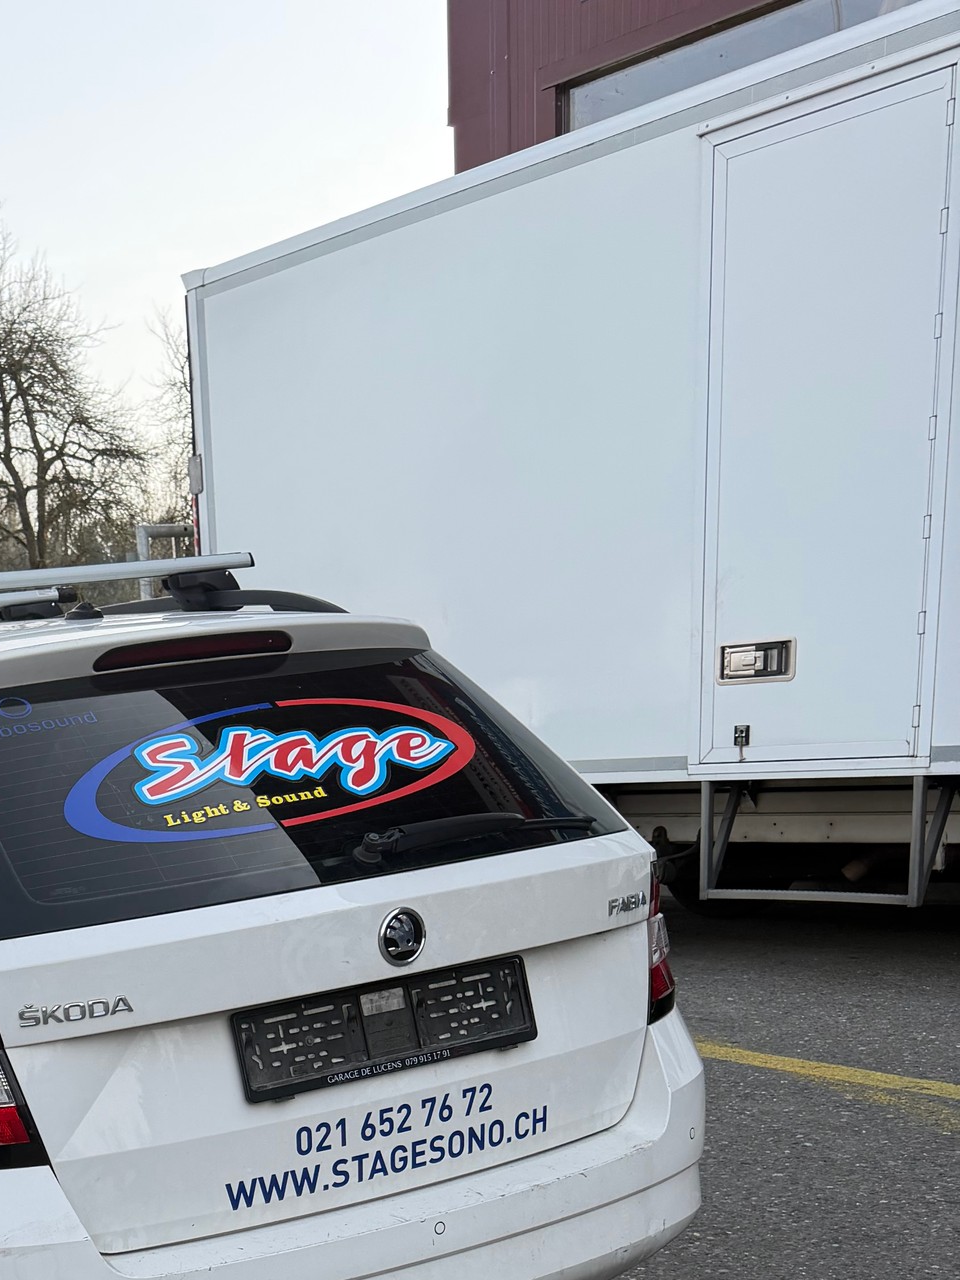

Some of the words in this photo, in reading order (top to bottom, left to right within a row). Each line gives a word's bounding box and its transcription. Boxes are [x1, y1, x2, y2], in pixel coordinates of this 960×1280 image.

[134, 726, 455, 805] Stage
[163, 803, 230, 827] Light
[233, 799, 250, 813] &
[256, 786, 328, 808] Sound
[608, 890, 647, 917] FABIA
[18, 994, 134, 1028] ŠKODA
[327, 1070, 360, 1083] GARAGE
[360, 1067, 372, 1076] DE
[373, 1060, 403, 1074] LUCENS
[405, 1057, 418, 1066] 079
[420, 1053, 432, 1064] 915
[442, 1049, 451, 1058] 91
[296, 1118, 347, 1156] 021
[360, 1103, 412, 1141] 652
[421, 1093, 453, 1127] 76
[462, 1083, 493, 1117] 72
[225, 1105, 548, 1211] WWW.STAGESONO.CH
